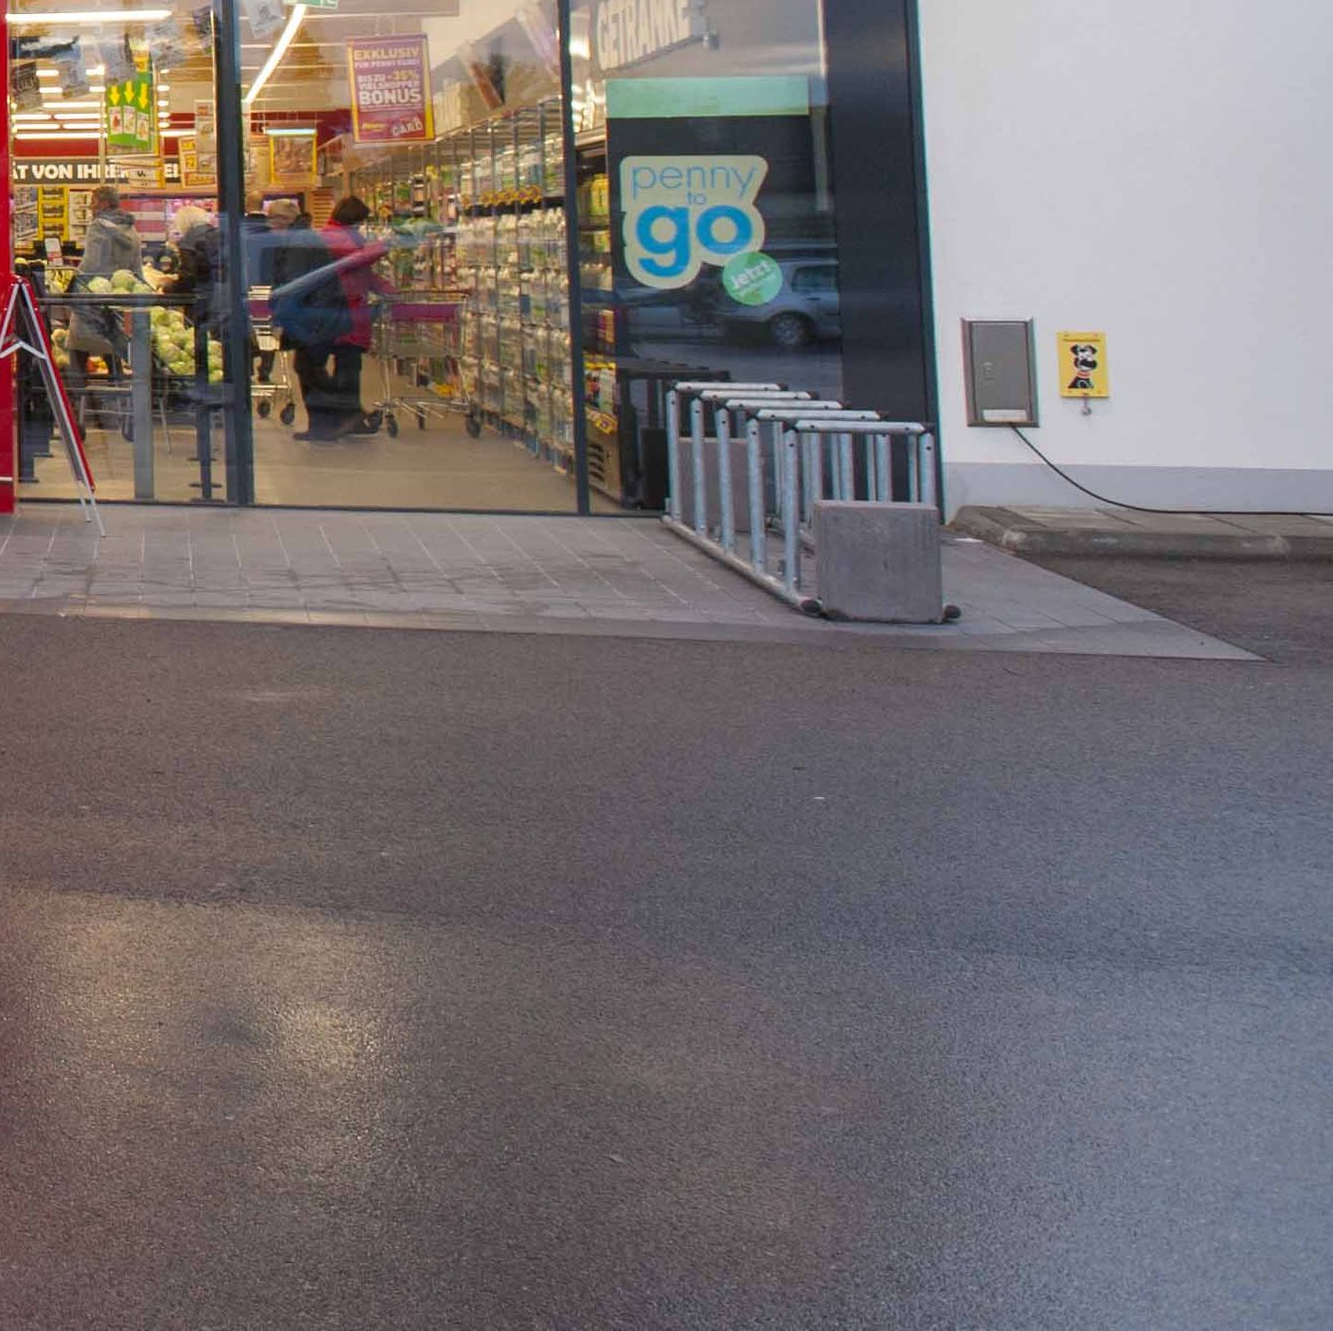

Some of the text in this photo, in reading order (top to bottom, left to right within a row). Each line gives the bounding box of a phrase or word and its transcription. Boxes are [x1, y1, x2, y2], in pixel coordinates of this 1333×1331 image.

[354, 46, 420, 60] EXKLUSIV
[359, 88, 421, 105] BONUS
[32, 164, 73, 180] VON
[630, 165, 757, 201] penny
[687, 192, 707, 205] to
[636, 205, 753, 277] go
